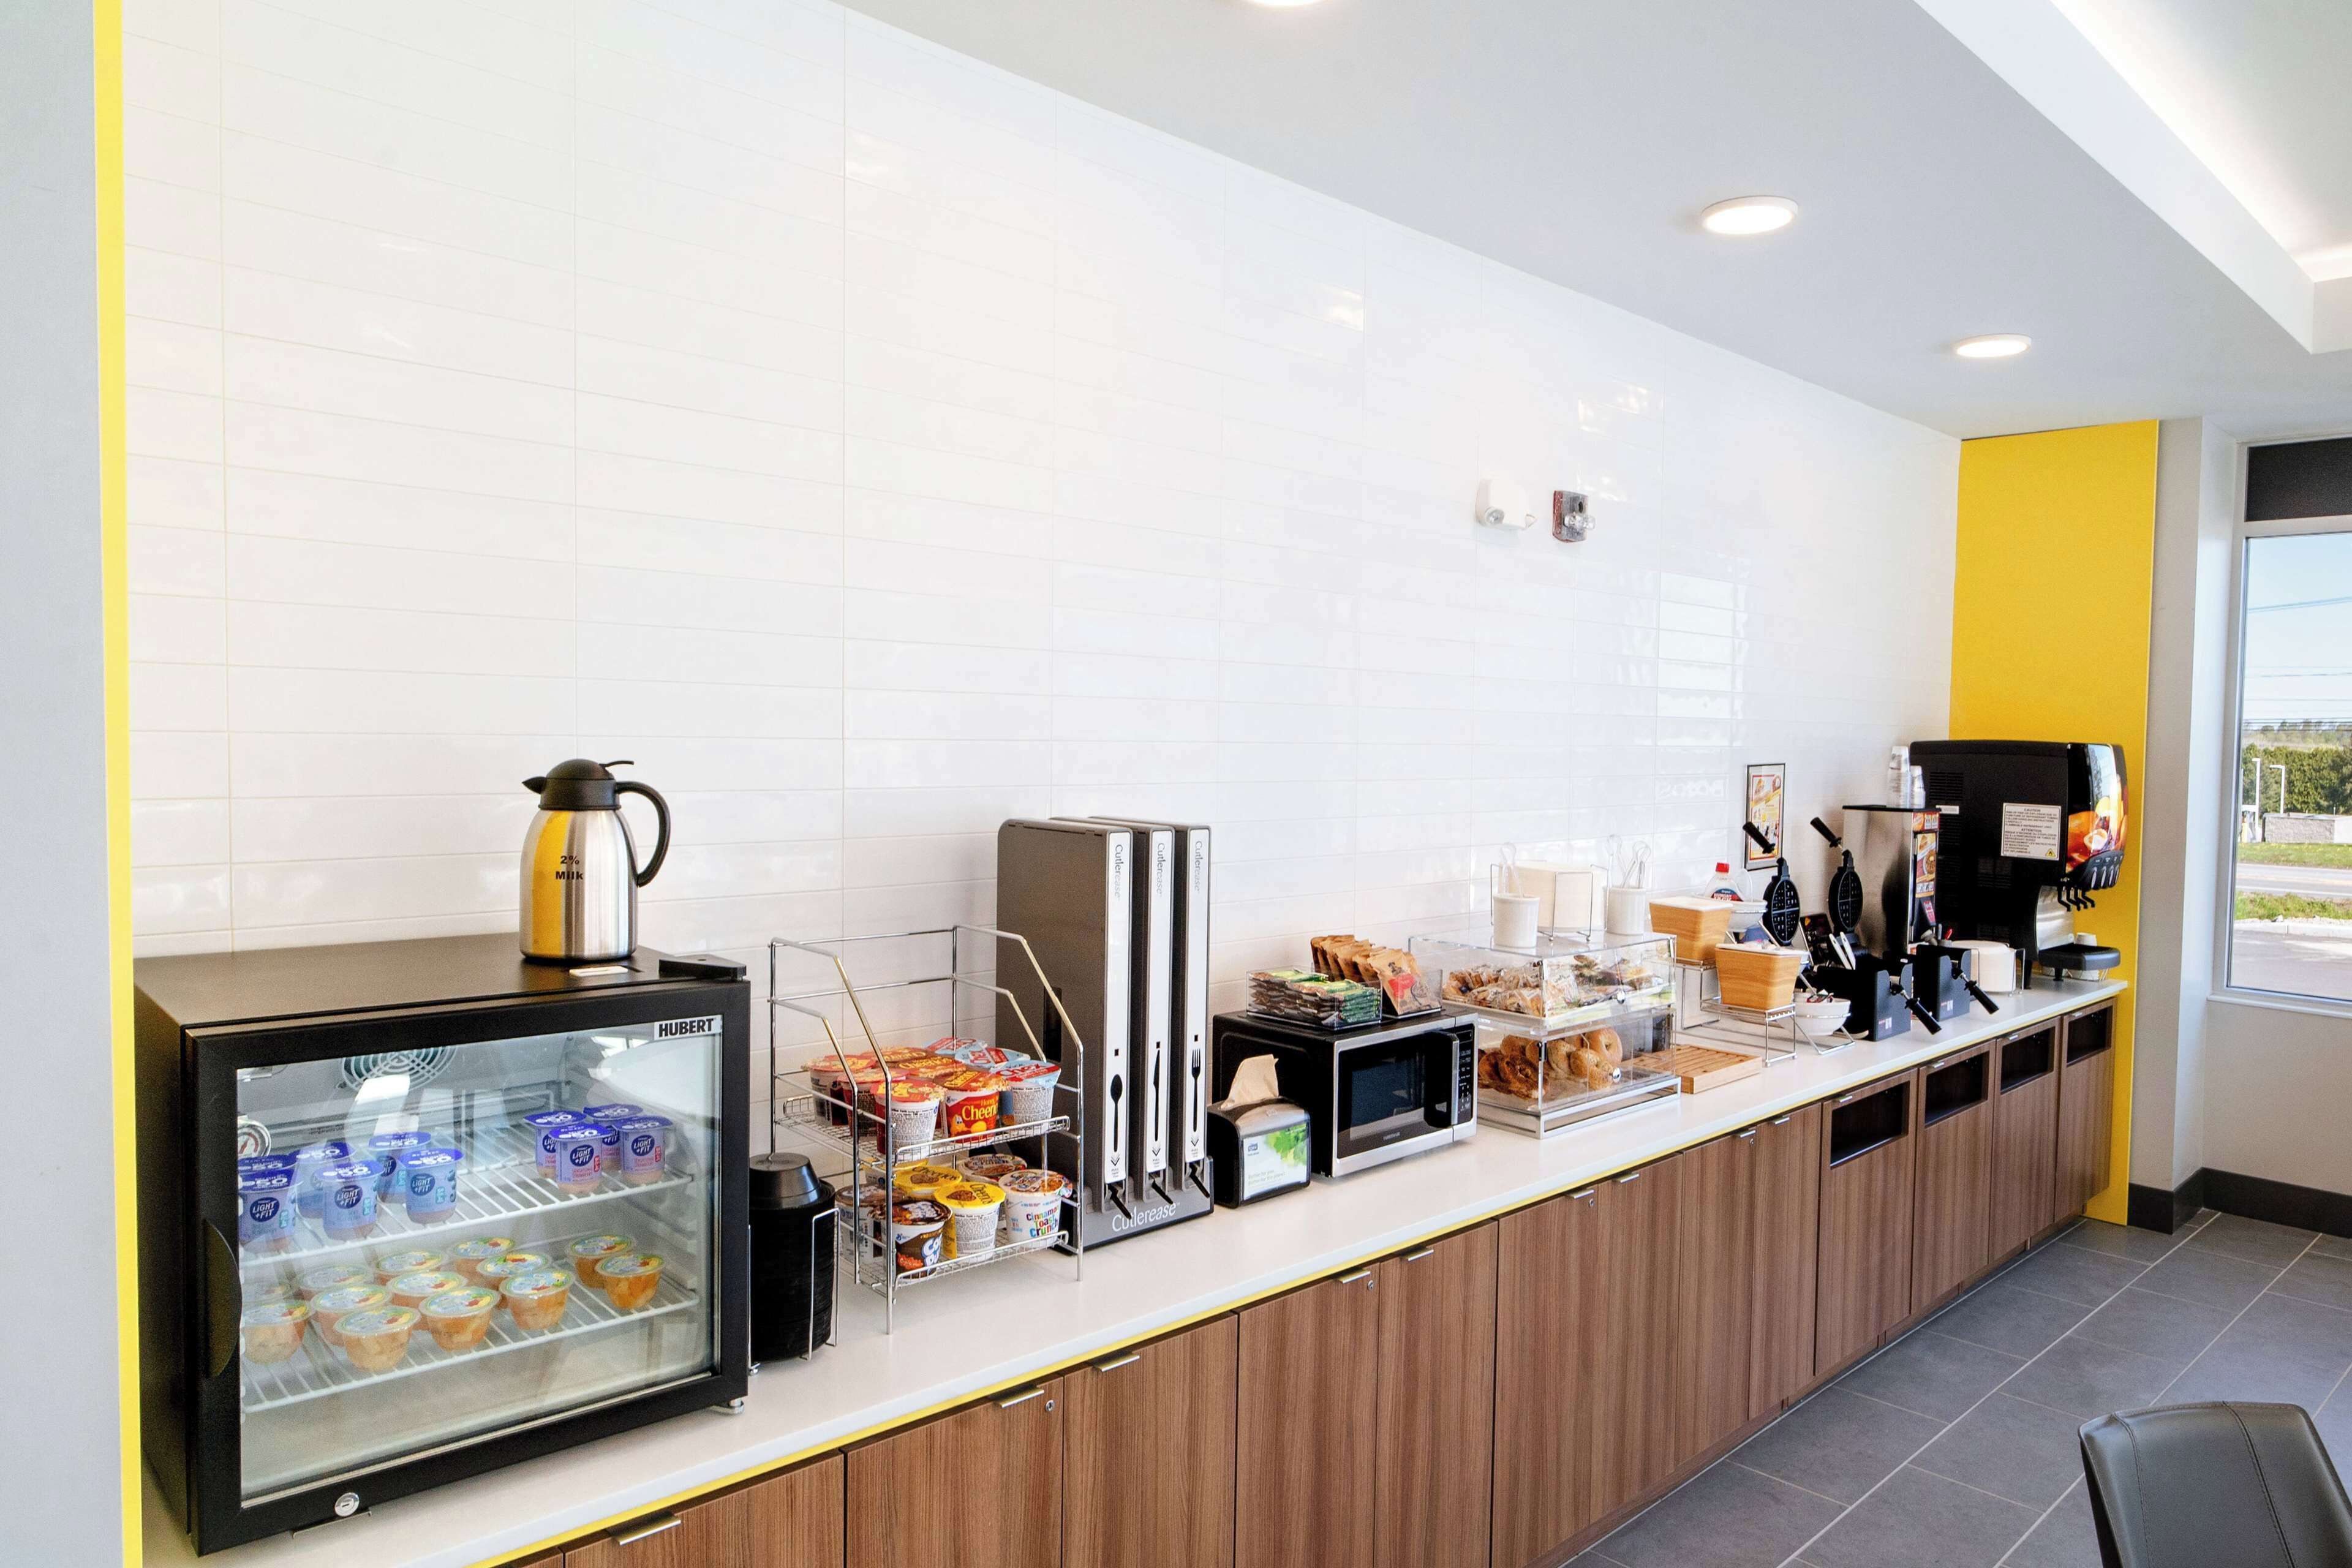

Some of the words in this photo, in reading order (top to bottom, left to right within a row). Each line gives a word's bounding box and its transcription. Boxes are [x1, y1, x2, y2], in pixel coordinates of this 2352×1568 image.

[560, 855, 579, 865] 2%
[556, 871, 583, 880] Milk
[658, 1018, 714, 1038] HUBERT
[1034, 1215, 1056, 1229] Toast
